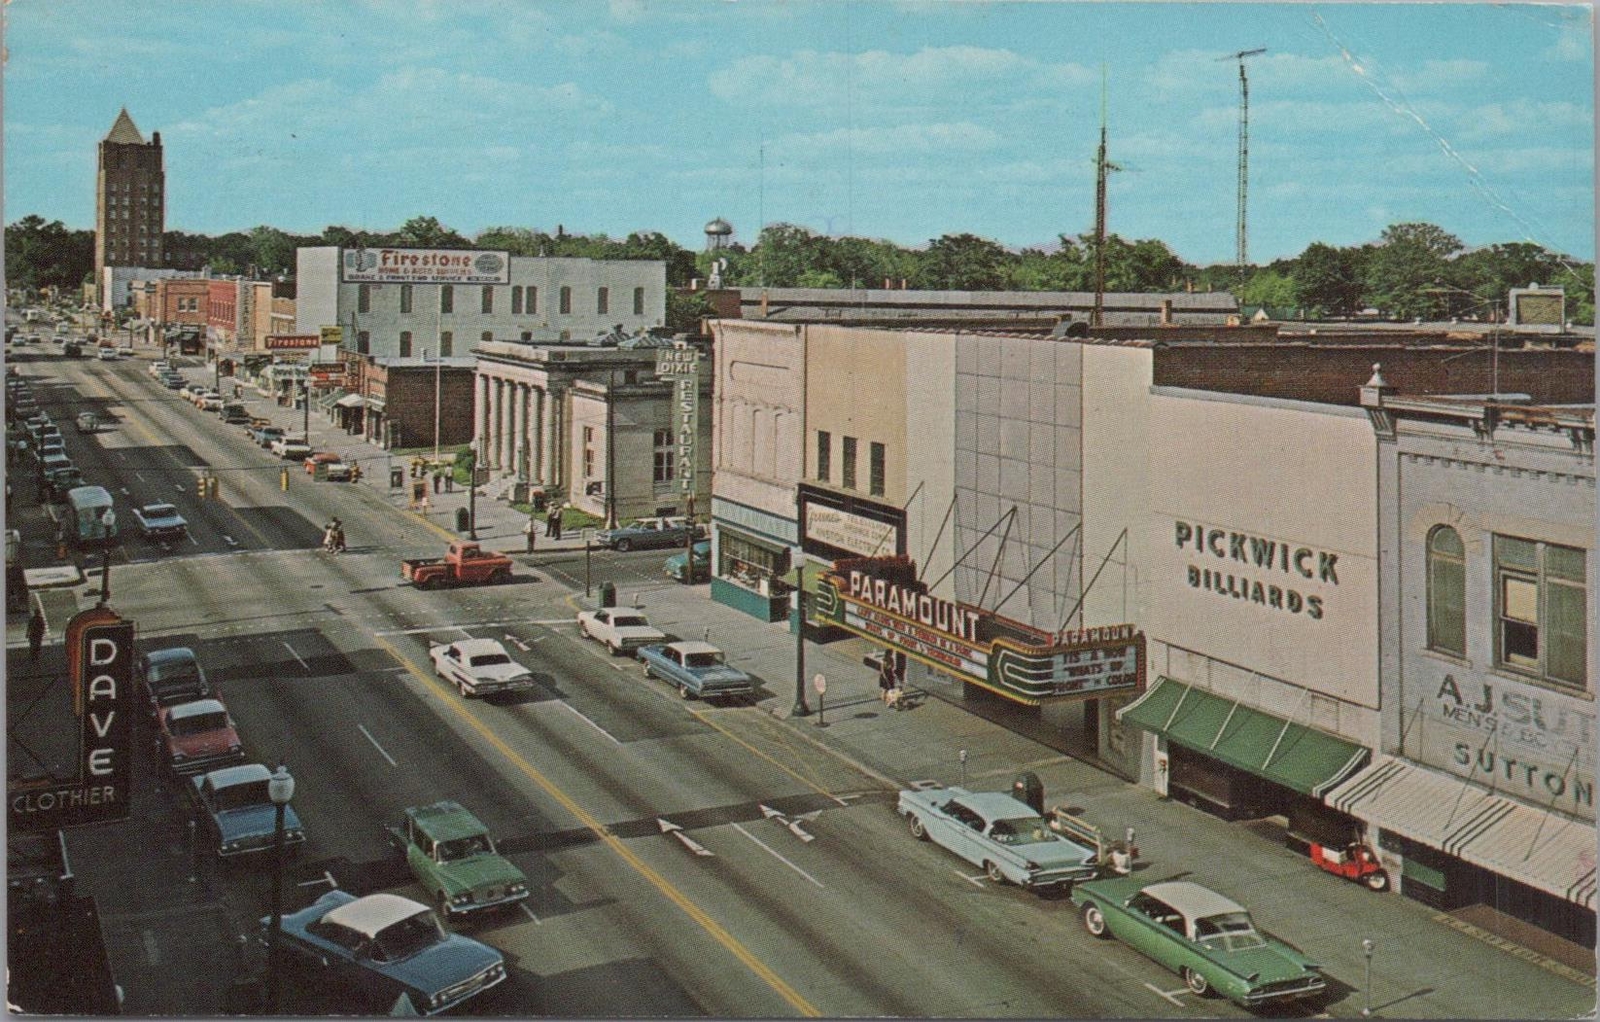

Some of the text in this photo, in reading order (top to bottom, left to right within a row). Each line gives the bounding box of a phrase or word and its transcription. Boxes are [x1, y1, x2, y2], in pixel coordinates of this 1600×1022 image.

[382, 250, 472, 267] Firestone
[267, 337, 318, 349] Firestone
[665, 352, 693, 362] NEW
[660, 361, 698, 375] DIXIE
[679, 378, 694, 490] RESTAURANT
[1175, 521, 1340, 586] PICKWICK
[850, 570, 980, 642] PARAMOUNT
[1187, 565, 1324, 620] BILLIARDS
[1053, 624, 1137, 647] PARAMOUNT
[89, 639, 118, 775] DAVE
[1453, 742, 1593, 807] SUTTON
[12, 786, 115, 813] CLOTHIER
